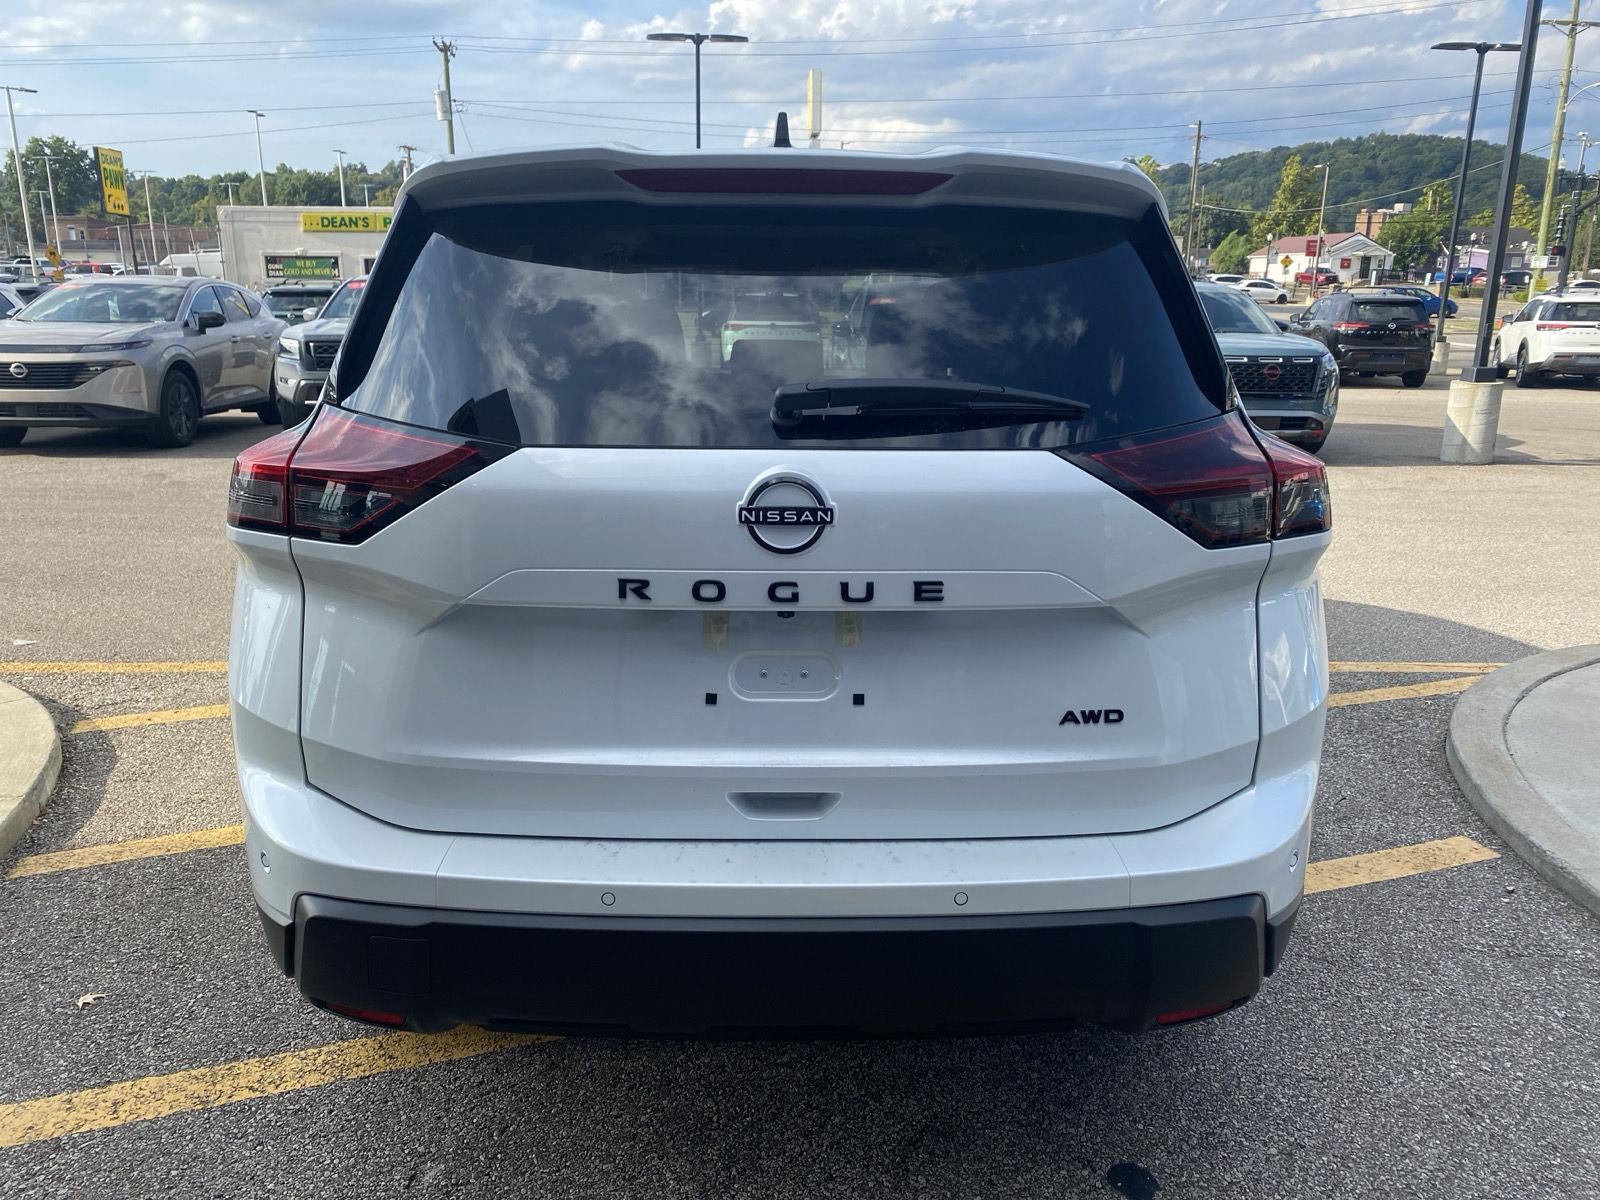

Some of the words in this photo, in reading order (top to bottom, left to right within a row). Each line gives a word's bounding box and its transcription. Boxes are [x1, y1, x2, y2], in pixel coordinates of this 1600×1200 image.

[103, 167, 125, 191] PAWN
[305, 259, 317, 268] BUY
[284, 267, 300, 276] GOLD
[301, 267, 313, 276] AND
[741, 510, 831, 523] NISSAN
[618, 577, 945, 603] ROGUE
[1058, 708, 1125, 726] AWD
